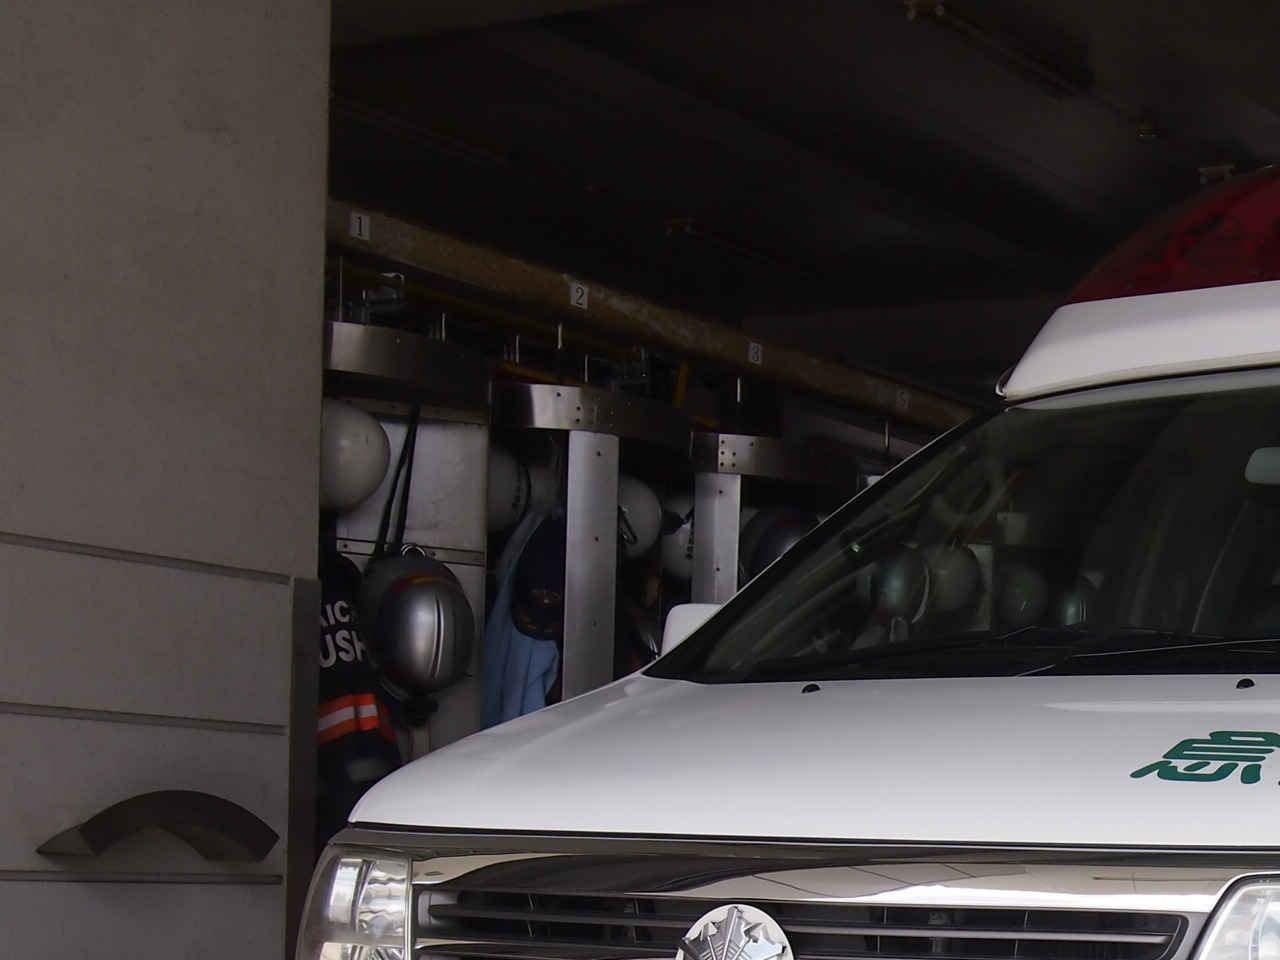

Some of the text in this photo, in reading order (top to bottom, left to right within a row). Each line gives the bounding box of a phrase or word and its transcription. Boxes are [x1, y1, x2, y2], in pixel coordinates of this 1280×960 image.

[356, 216, 363, 237] 1
[574, 286, 584, 306] 2
[751, 345, 760, 362] 3
